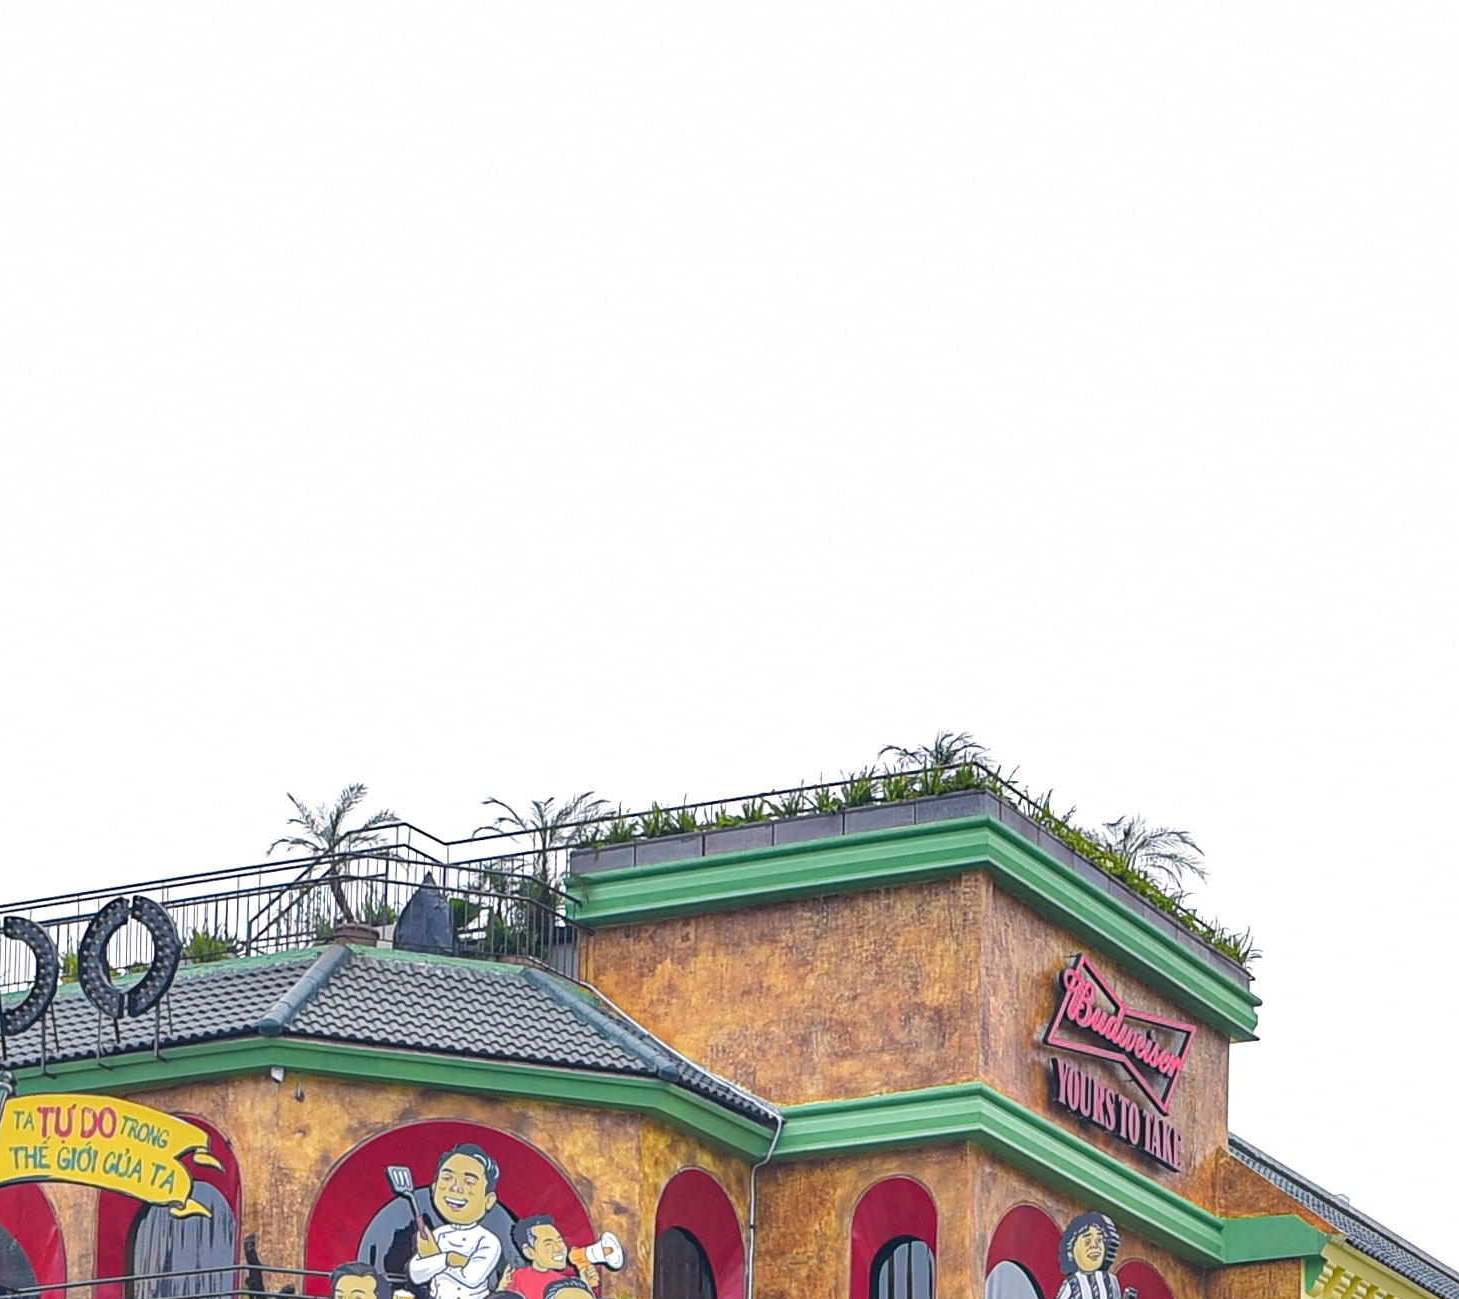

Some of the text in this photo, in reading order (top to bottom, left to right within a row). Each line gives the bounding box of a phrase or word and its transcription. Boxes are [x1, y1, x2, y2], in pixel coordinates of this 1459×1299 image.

[1060, 967, 1185, 1078] Budweiser
[13, 1103, 170, 1149] TA TỰ DO TRONG
[1053, 1059, 1184, 1172] YOURS TO TAKE
[9, 1137, 177, 1195] THẾ GIỚI CỦA TA
